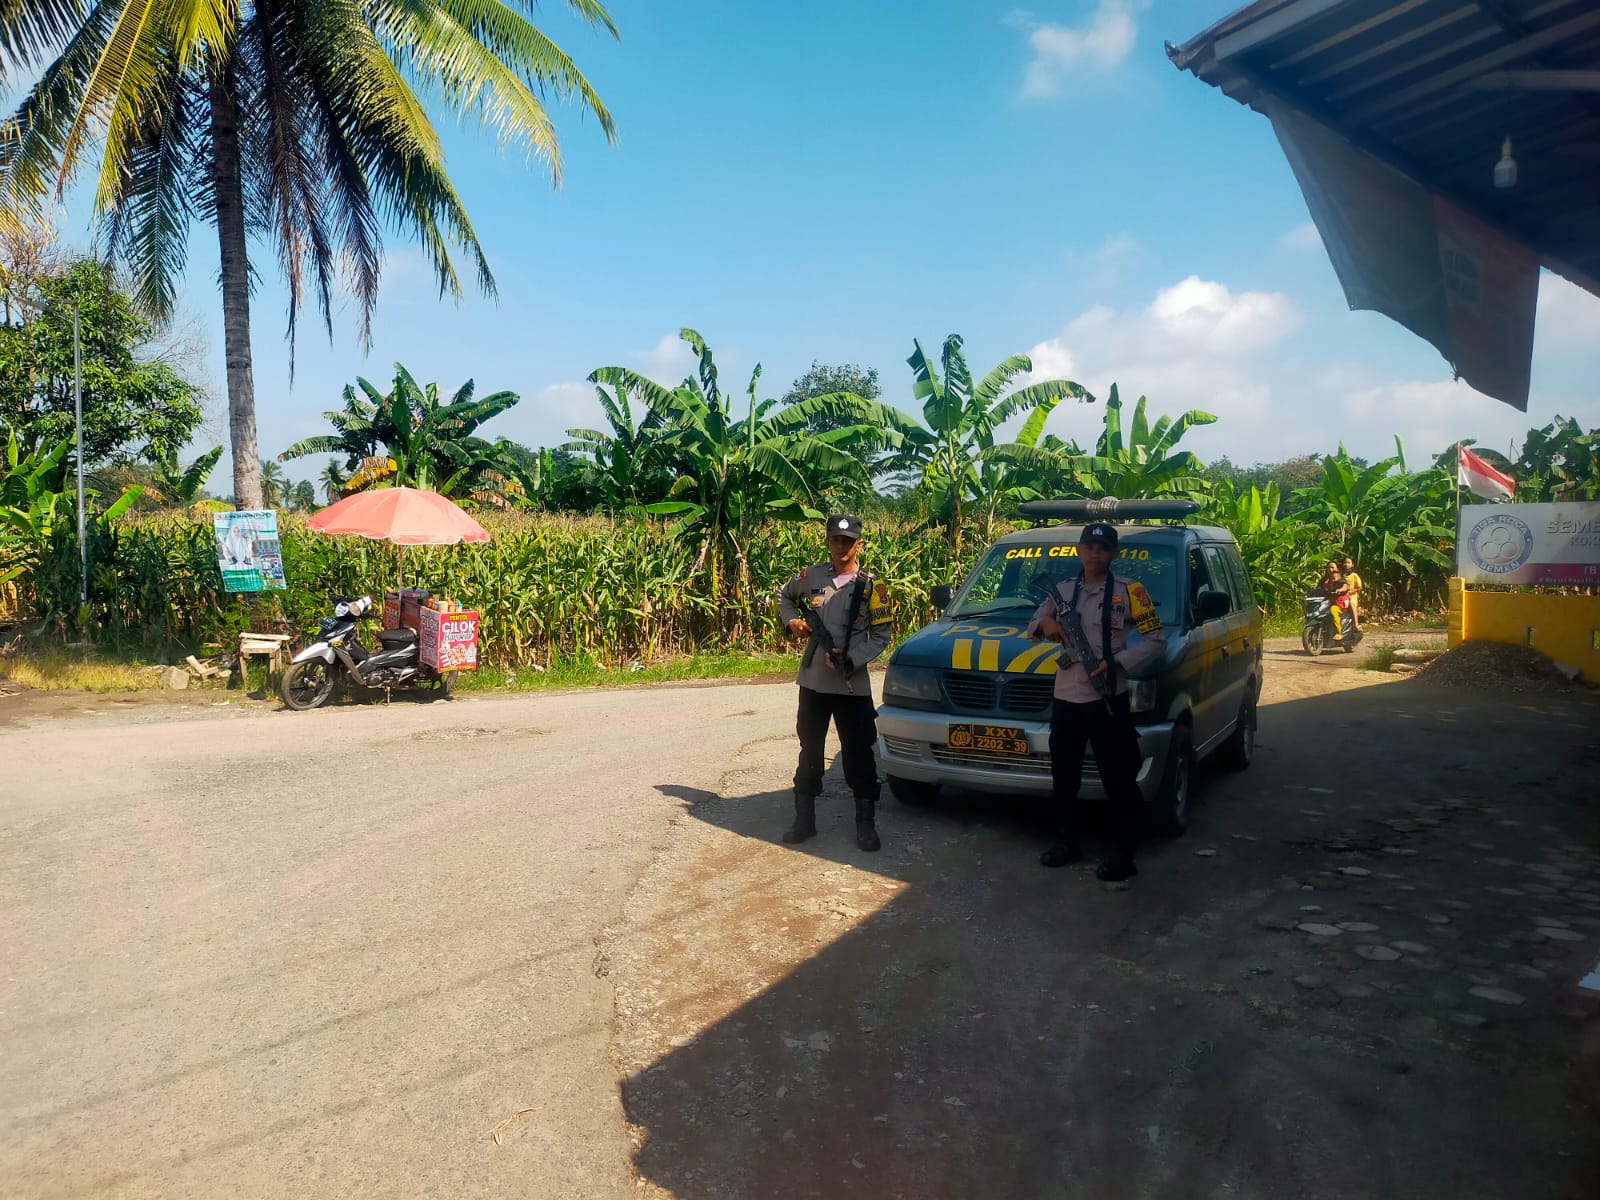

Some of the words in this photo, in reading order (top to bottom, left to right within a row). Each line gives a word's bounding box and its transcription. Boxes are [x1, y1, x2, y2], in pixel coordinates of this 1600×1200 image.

[1472, 517, 1496, 535] TIGA
[1499, 515, 1528, 533] RODA
[1005, 547, 1042, 560] CALL
[1048, 546, 1080, 558] CEN
[1119, 548, 1150, 561] 110
[1479, 561, 1520, 573] SEMEN
[1098, 602, 1125, 614] PLRI
[442, 620, 476, 633] CILOK
[984, 726, 1019, 738] XXV
